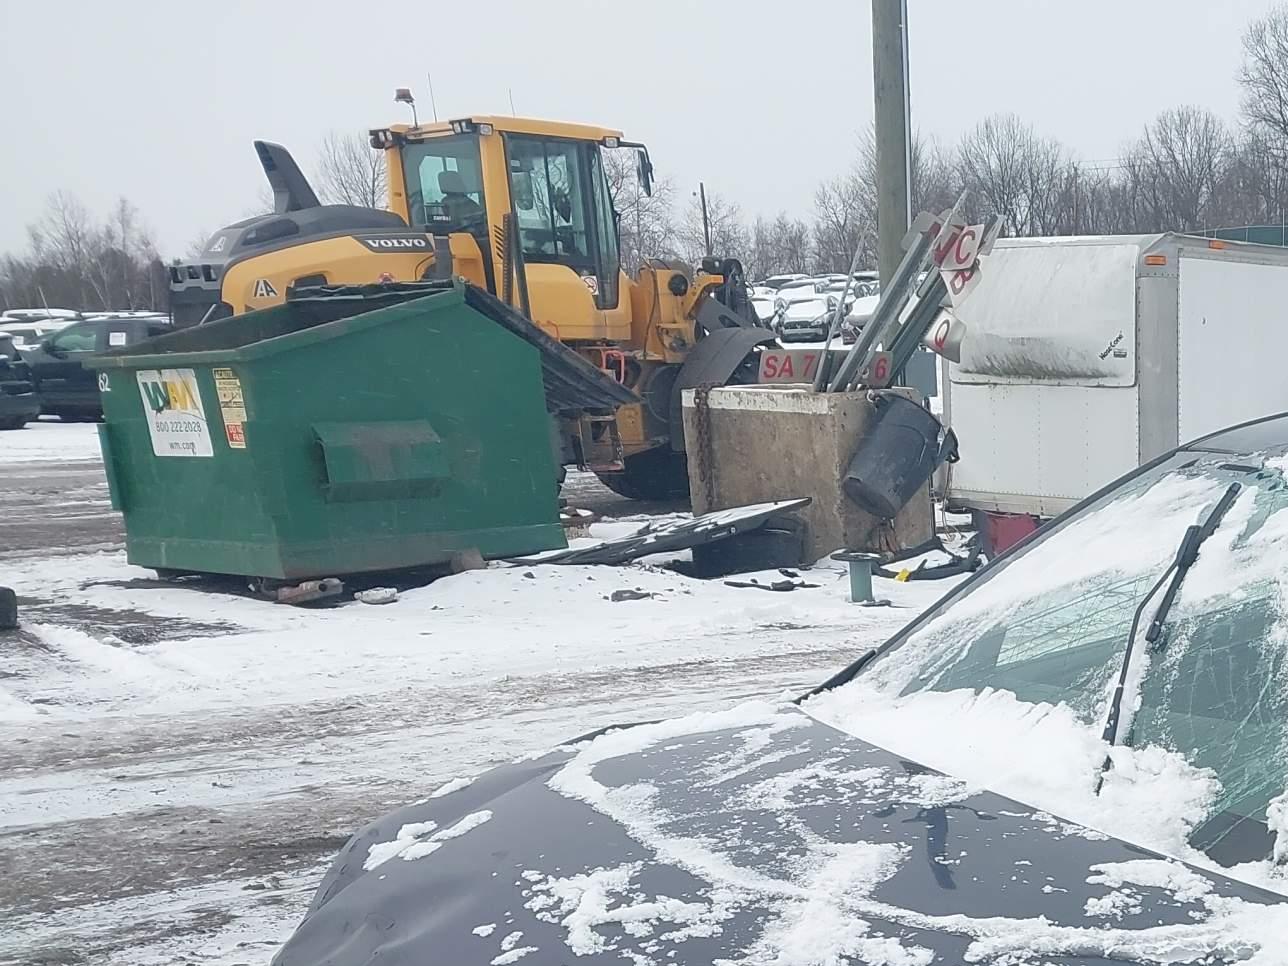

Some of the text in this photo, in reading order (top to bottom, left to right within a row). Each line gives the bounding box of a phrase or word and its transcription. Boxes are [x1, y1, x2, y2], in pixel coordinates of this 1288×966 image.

[366, 239, 426, 248] VOLVO
[955, 230, 976, 265] C
[763, 355, 794, 379] SA
[155, 421, 169, 432] 800
[170, 421, 183, 432] 222
